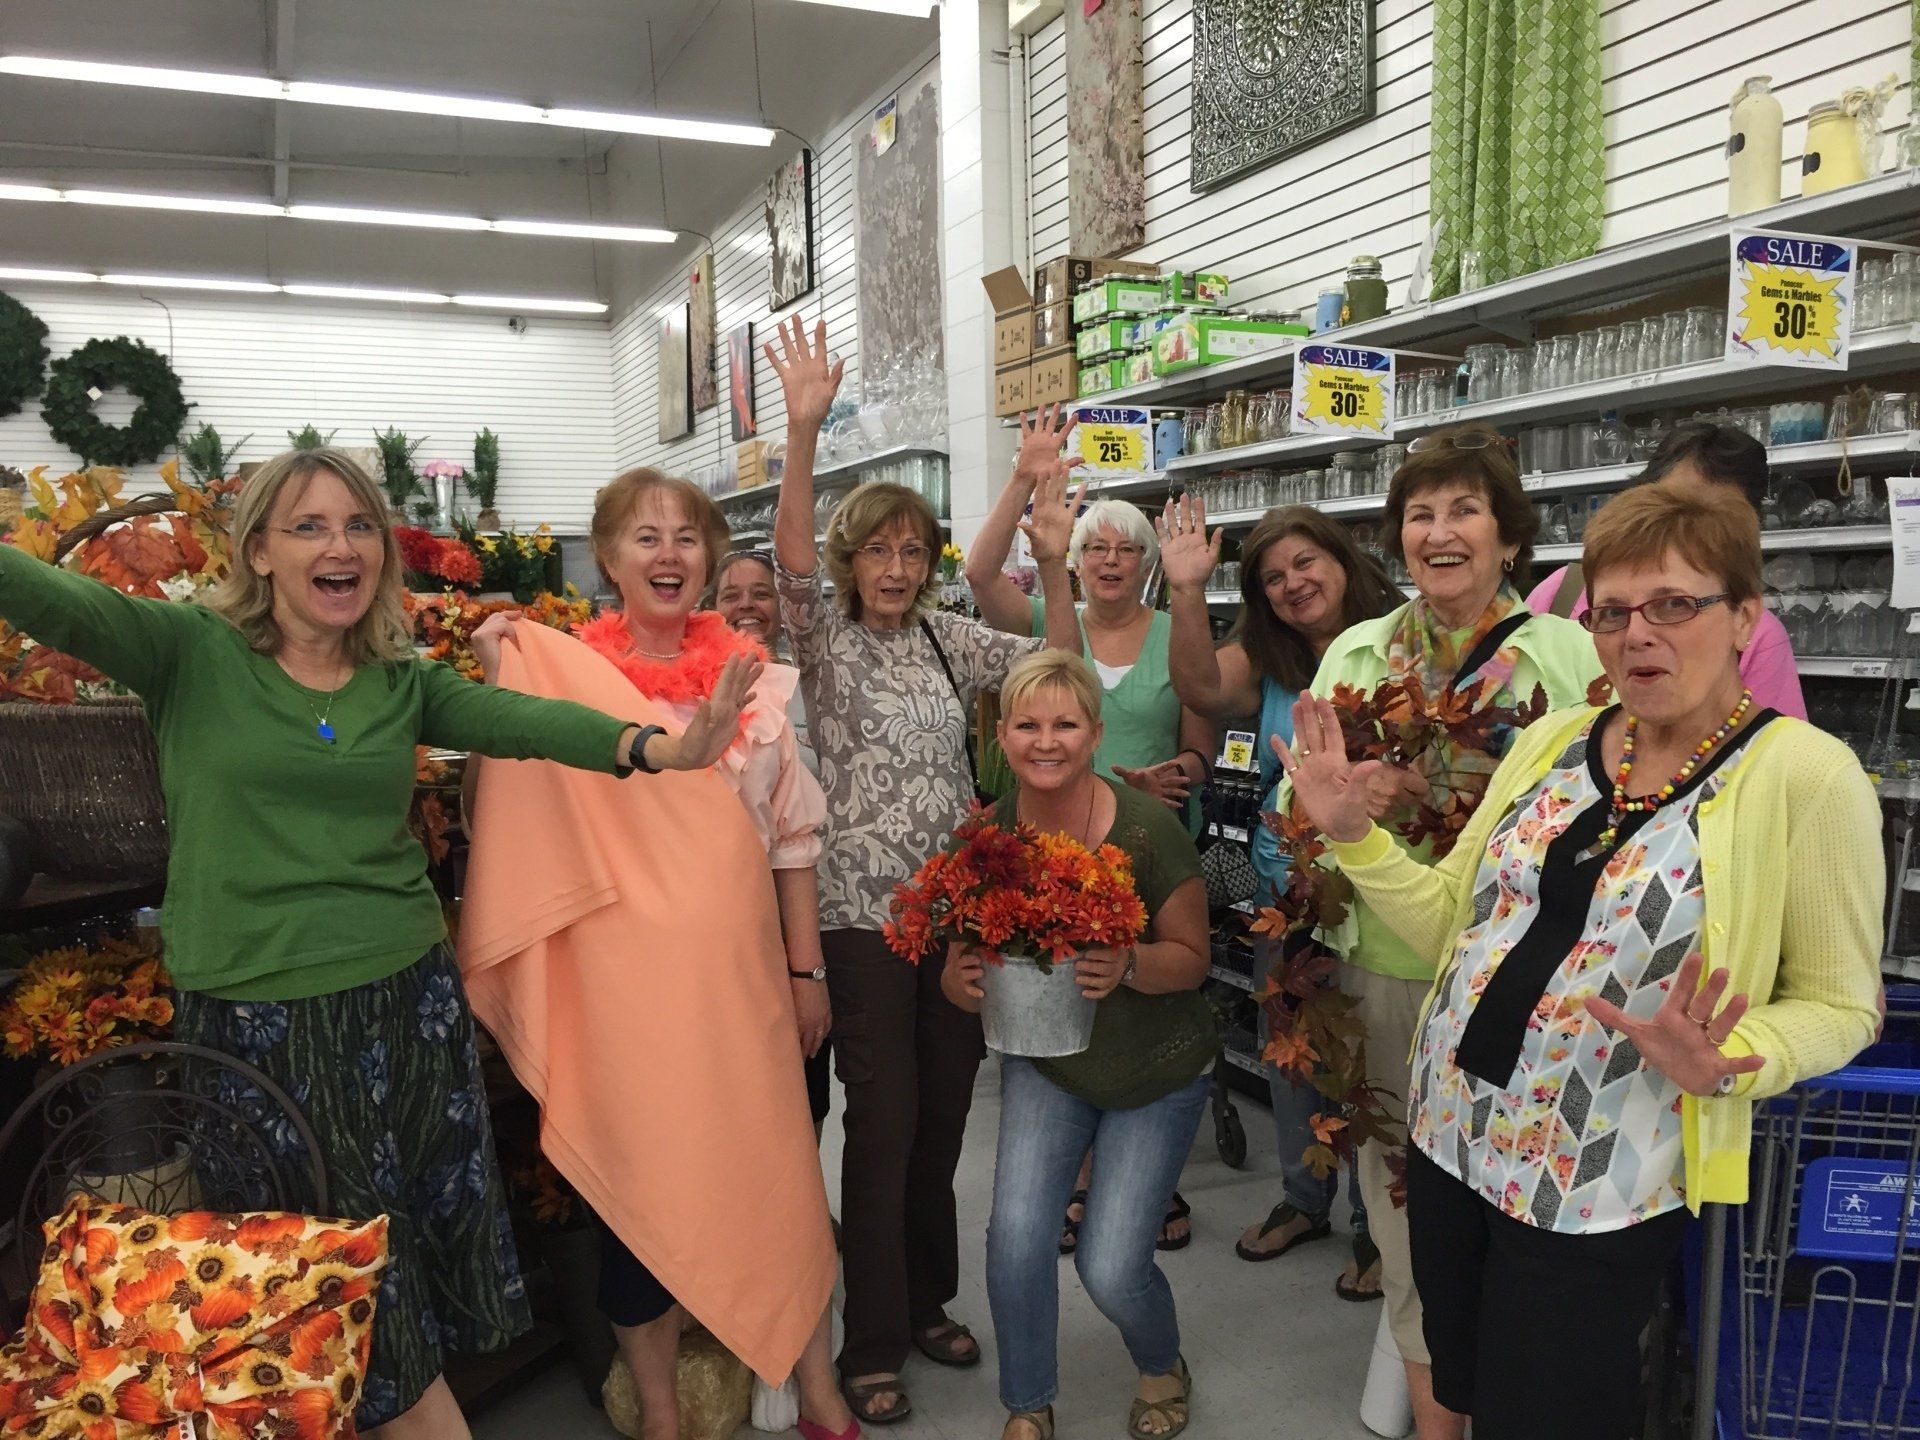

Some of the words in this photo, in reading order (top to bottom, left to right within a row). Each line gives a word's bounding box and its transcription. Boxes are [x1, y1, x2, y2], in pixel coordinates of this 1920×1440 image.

[1767, 239, 1824, 267] SALE
[1074, 263, 1086, 279] 6
[1038, 272, 1044, 287] 6
[1761, 286, 1783, 299] Gems
[1784, 289, 1790, 300] &
[1791, 289, 1822, 303] Marbles
[1037, 316, 1044, 331] 6
[1774, 302, 1807, 339] 30
[1808, 305, 1817, 319] %
[1323, 347, 1369, 368] SALE
[1319, 379, 1337, 390] Gems
[1344, 382, 1370, 393] Marbles
[1331, 391, 1358, 418] 30
[1358, 393, 1366, 404] %
[1091, 409, 1130, 423] SALE
[1093, 434, 1115, 442] Canning
[1100, 442, 1122, 463] 25
